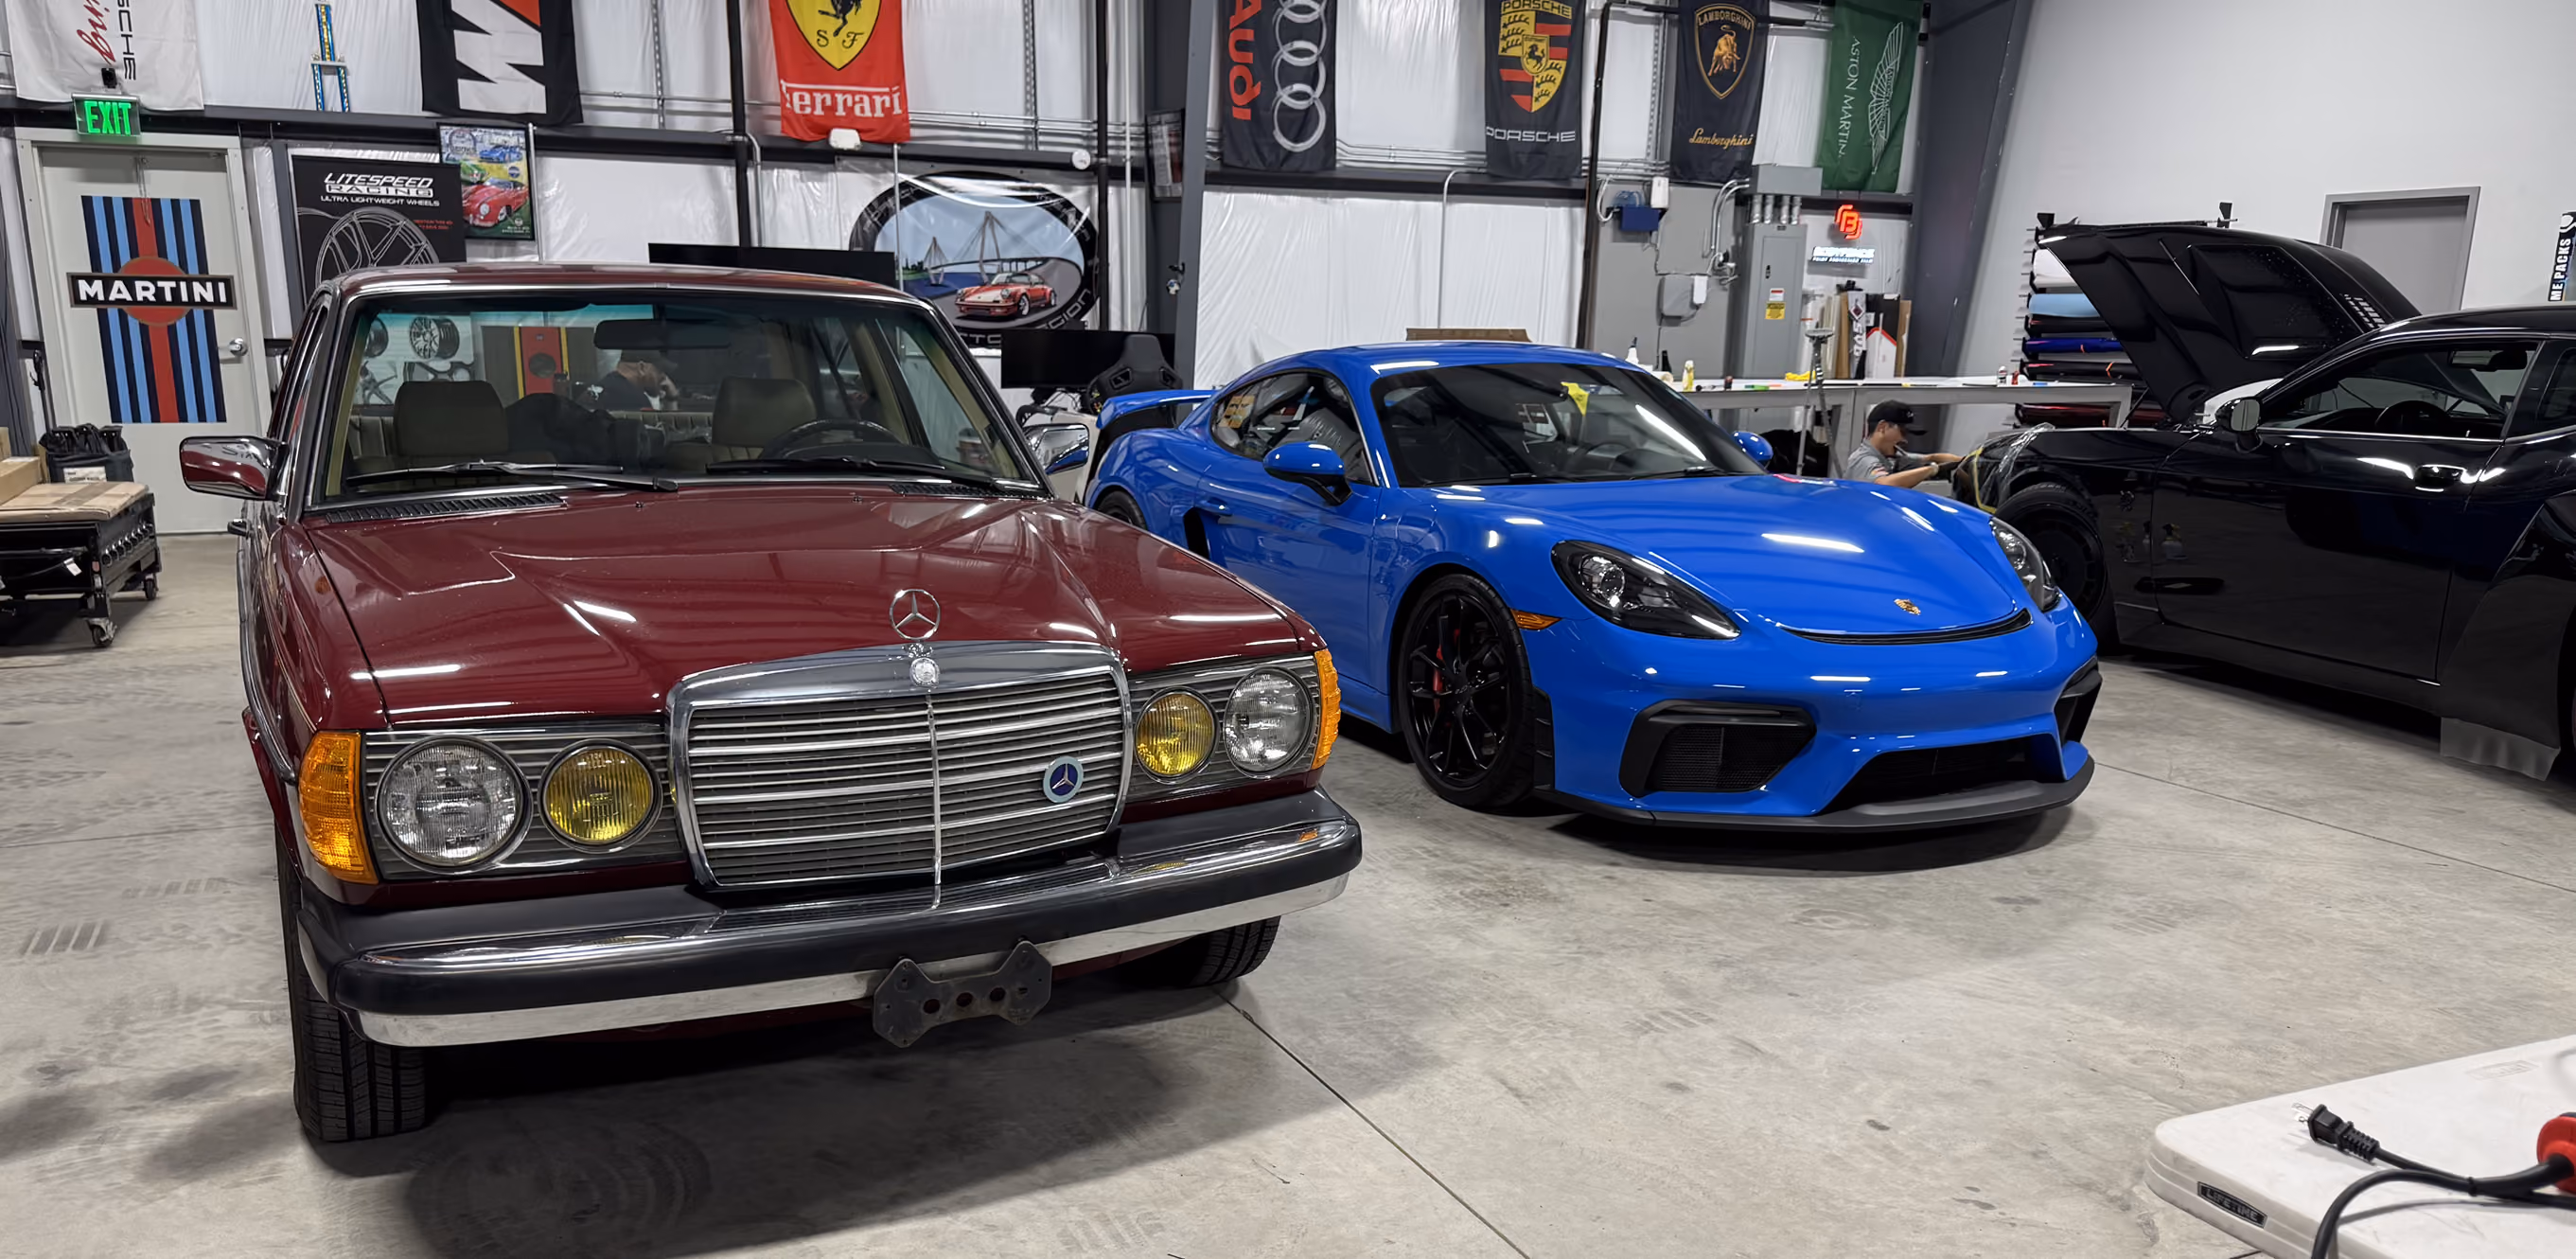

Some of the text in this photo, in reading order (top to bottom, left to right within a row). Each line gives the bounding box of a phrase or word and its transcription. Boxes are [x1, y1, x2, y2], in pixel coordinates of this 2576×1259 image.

[1698, 10, 1752, 30] LAMBORGHINI
[817, 29, 865, 49] S F
[1837, 36, 1861, 157] ASTON MARTIN
[84, 100, 132, 135] EXIT
[1486, 126, 1576, 142] PORSCHE
[1688, 128, 1754, 150] Lamborghini
[324, 172, 433, 188] LITESPEED
[326, 186, 432, 197] RACING
[350, 196, 404, 205] LIGHTWEIGHT
[406, 199, 440, 207] WHEELS
[2553, 238, 2571, 280] PACKS
[78, 279, 227, 303] MARTINI
